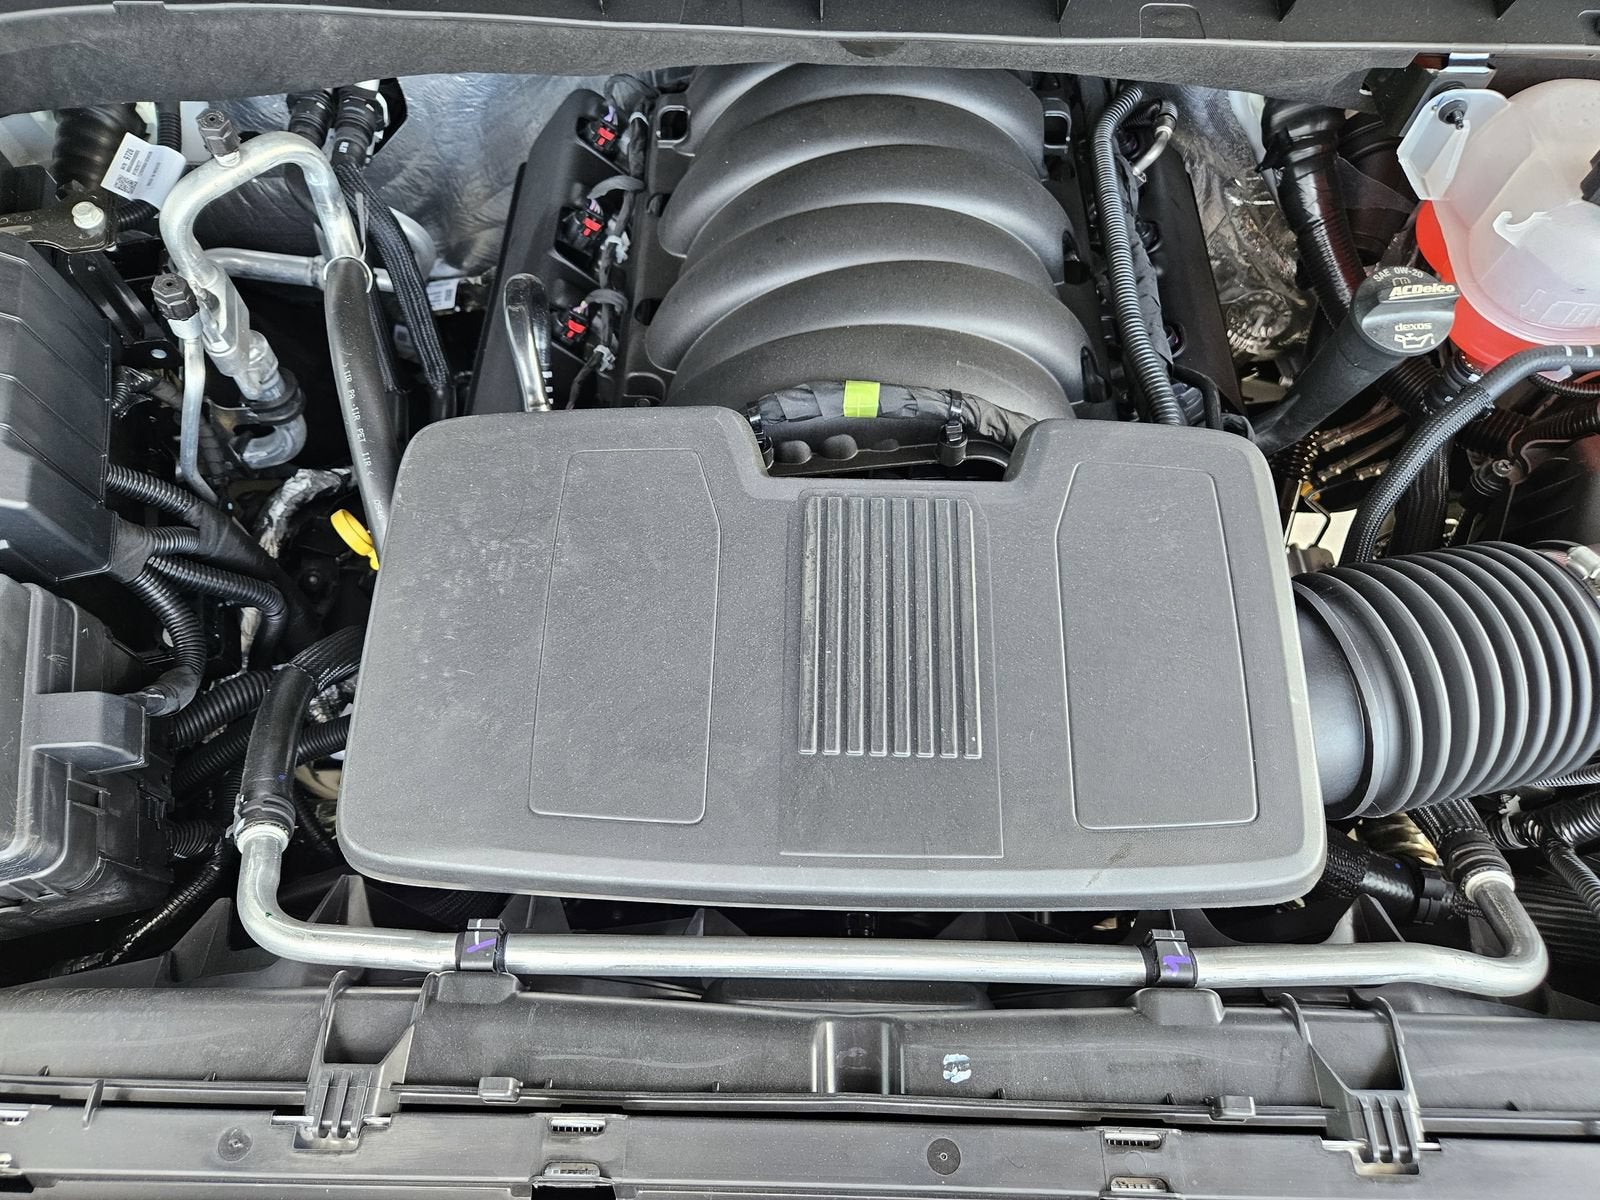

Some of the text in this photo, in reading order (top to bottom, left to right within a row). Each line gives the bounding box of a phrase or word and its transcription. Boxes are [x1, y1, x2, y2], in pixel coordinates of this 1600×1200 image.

[1373, 268, 1392, 283] SAE
[1389, 283, 1455, 297] ACDelco
[1394, 323, 1433, 331] dexos
[356, 427, 367, 443] PET
